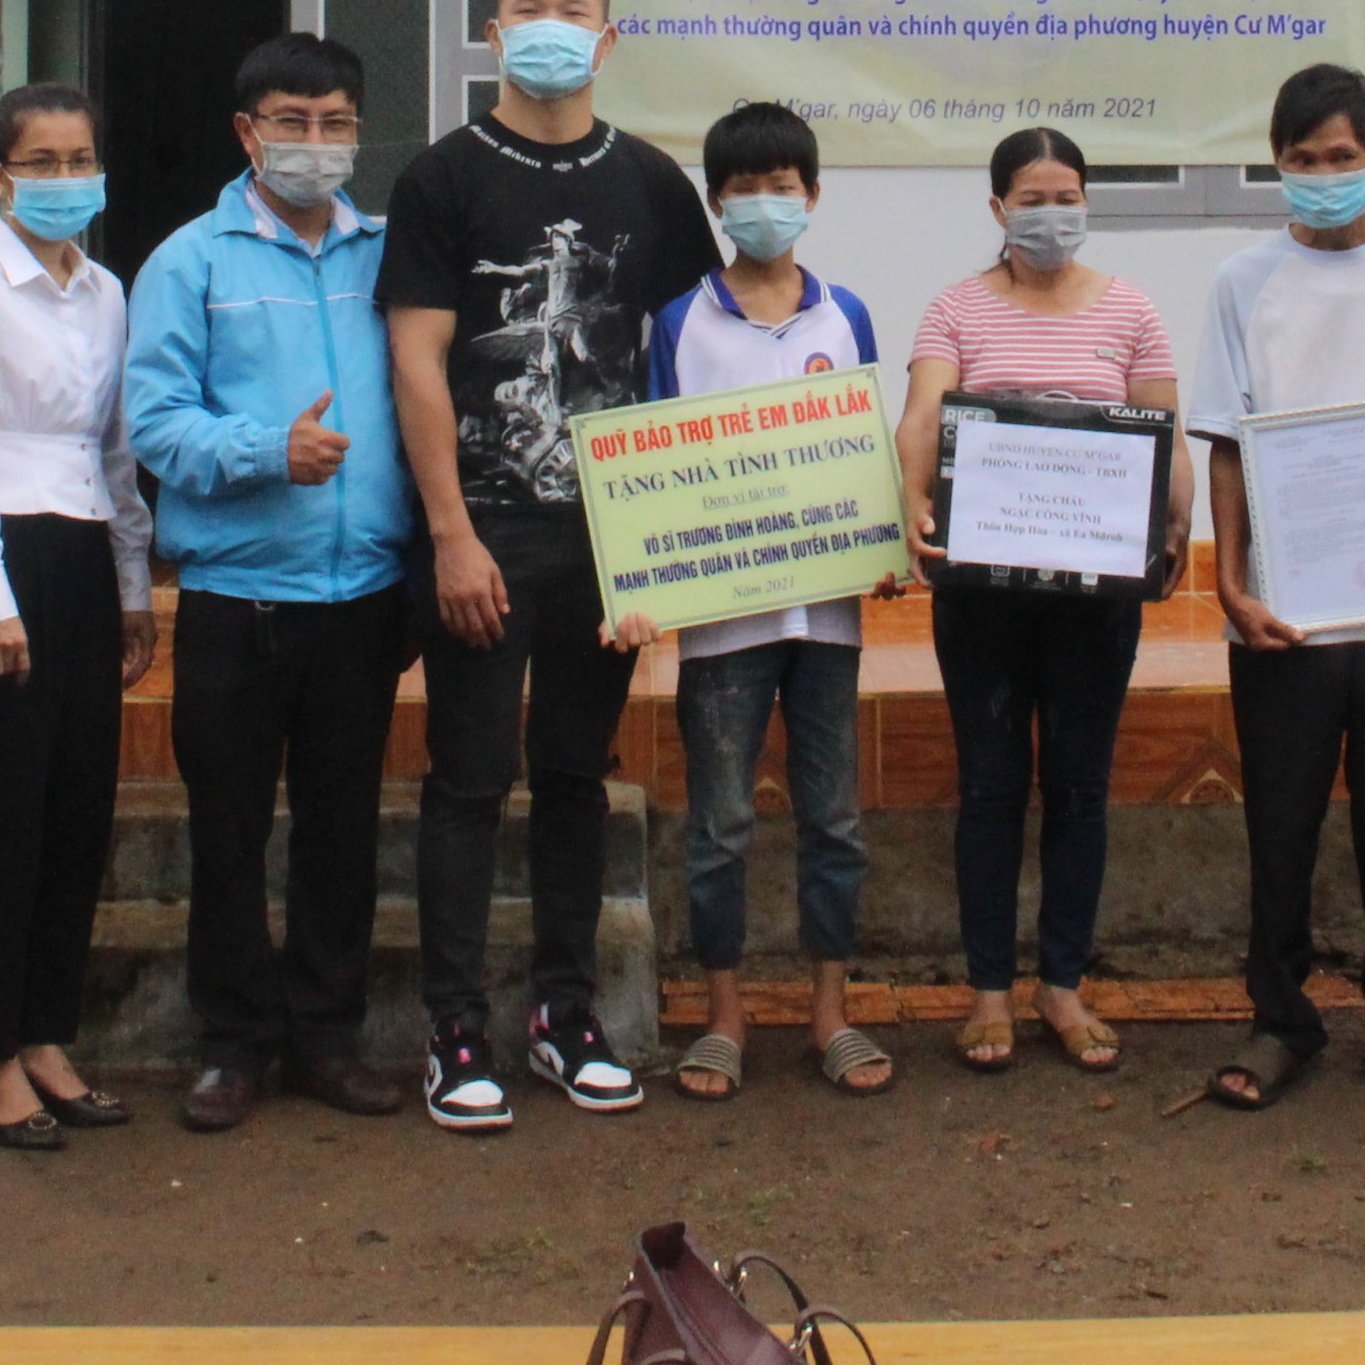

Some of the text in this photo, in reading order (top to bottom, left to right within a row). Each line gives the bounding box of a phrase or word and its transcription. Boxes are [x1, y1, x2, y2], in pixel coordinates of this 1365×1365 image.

[617, 13, 651, 36] các
[657, 14, 717, 43] mạnh
[723, 14, 802, 41] thường
[807, 15, 862, 42] quân
[868, 14, 892, 36] và
[898, 14, 957, 36] chính
[1035, 14, 1068, 43] địa
[1074, 15, 1157, 41] phương
[1163, 15, 1228, 42] huyện
[1235, 14, 1262, 36] Cư
[848, 99, 901, 124] ngày
[909, 98, 936, 119] 06
[943, 99, 1006, 123] tháng
[1015, 98, 1041, 119] 10
[1048, 98, 1095, 119] năm
[1103, 98, 1156, 119] 2021
[945, 408, 987, 422] RICE
[1109, 406, 1167, 421] KALITE
[590, 428, 626, 462] QUỸ
[633, 420, 672, 453] BẢO
[676, 415, 714, 446] TRỢ
[717, 402, 754, 437] TRẺ
[757, 404, 788, 430] EM
[603, 434, 875, 502] TẶNG NHÀ TÌNH THƯƠNG
[835, 496, 859, 520] CÁC
[613, 568, 650, 594] MẠNH
[700, 551, 733, 578] QUÂN
[753, 542, 789, 566] CHÍNH
